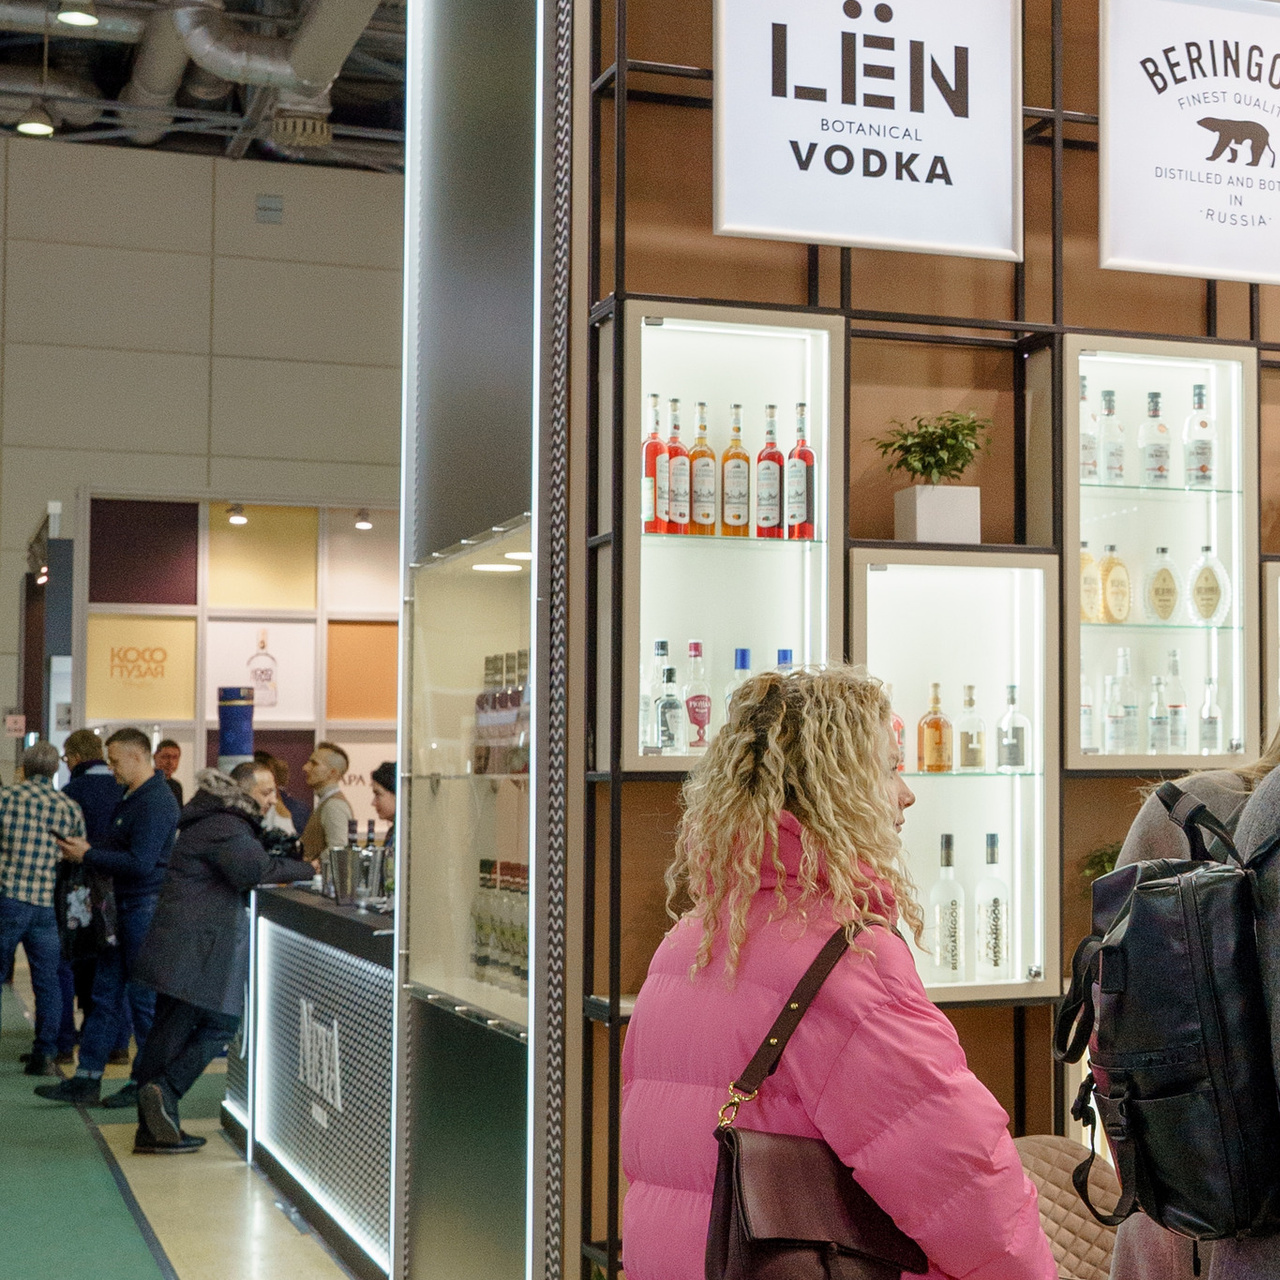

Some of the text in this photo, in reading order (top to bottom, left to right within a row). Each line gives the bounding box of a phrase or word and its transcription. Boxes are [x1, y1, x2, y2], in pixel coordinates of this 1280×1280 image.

[1177, 91, 1228, 110] FINEST
[820, 118, 924, 142] BOTANICAL
[789, 139, 954, 186] VODKA
[1154, 166, 1223, 186] DISTILLED
[1226, 175, 1255, 190] AND
[1229, 194, 1243, 207] IN
[110, 646, 168, 663] КОСО
[110, 664, 165, 678] ПУЗАЯ
